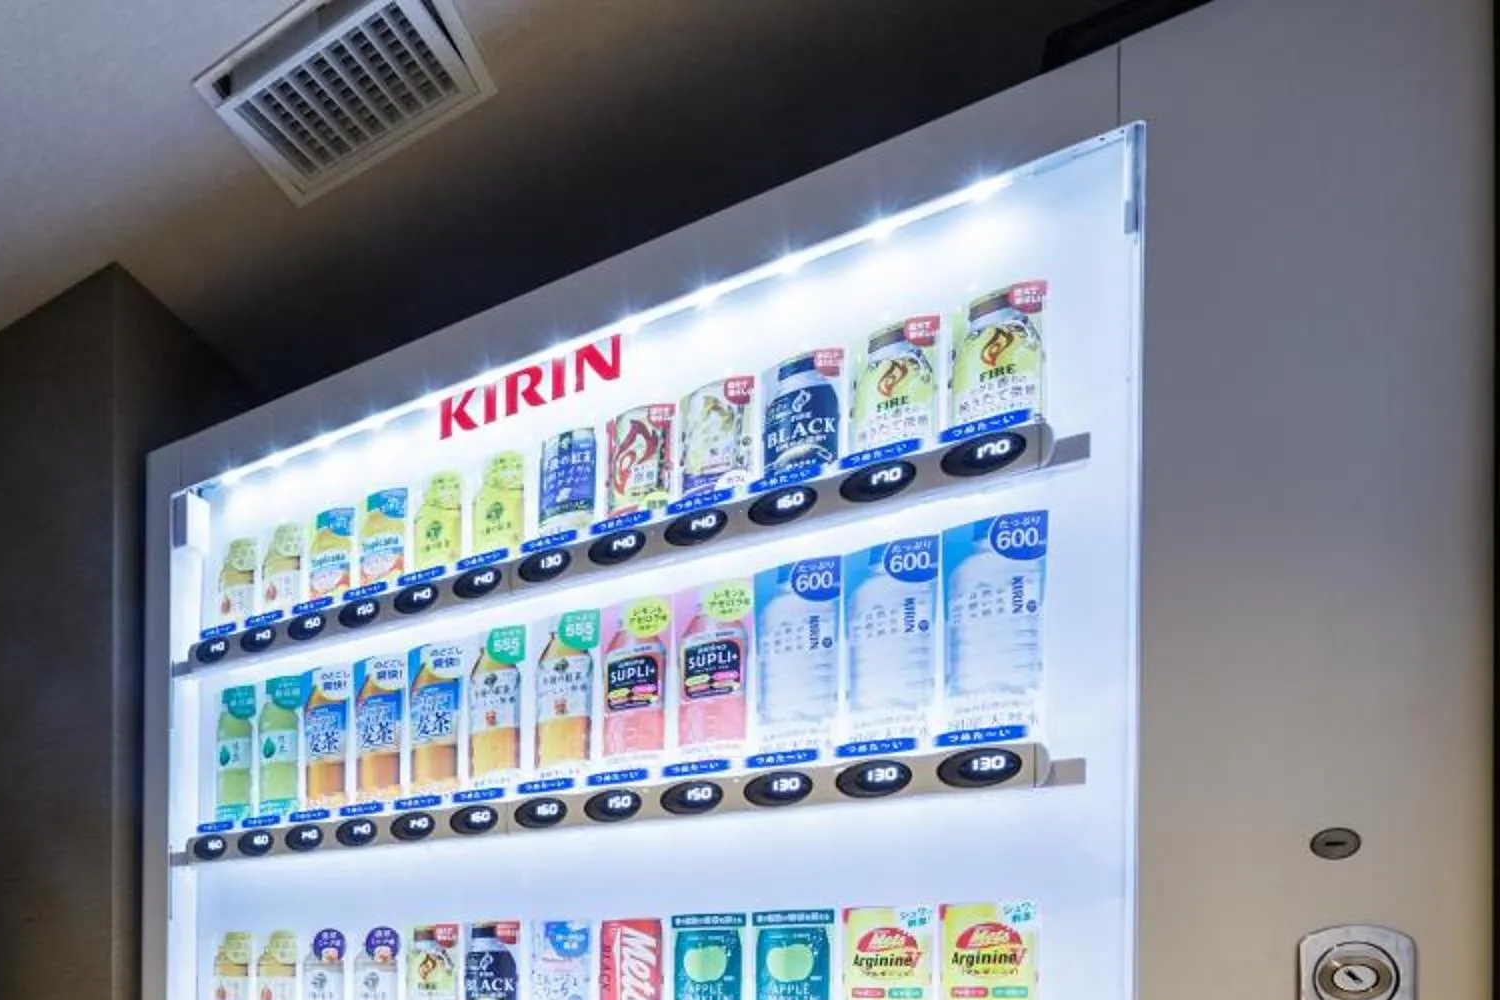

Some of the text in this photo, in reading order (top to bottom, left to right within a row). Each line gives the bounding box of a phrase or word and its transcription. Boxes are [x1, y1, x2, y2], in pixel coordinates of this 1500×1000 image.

[980, 364, 1017, 382] FIRE
[439, 333, 621, 441] KIRIN
[766, 416, 836, 449] BLACK
[977, 438, 1011, 459] 170
[871, 466, 902, 485] 170
[776, 491, 805, 509] 160
[691, 514, 717, 531] 140
[612, 534, 637, 551] 140
[995, 527, 1040, 550] 600
[540, 553, 563, 569] 130
[889, 551, 931, 574] 600
[473, 571, 494, 586] 140
[795, 571, 833, 592] 600
[413, 587, 432, 601] 140
[972, 755, 1006, 771] 130
[867, 766, 898, 783] 130
[772, 776, 801, 793] 130
[608, 795, 632, 809] 150
[686, 786, 713, 801] 150
[470, 809, 491, 823] 160
[536, 803, 559, 816] 160
[353, 822, 371, 835] 140
[409, 817, 429, 829] 140
[852, 952, 913, 969] Arginine
